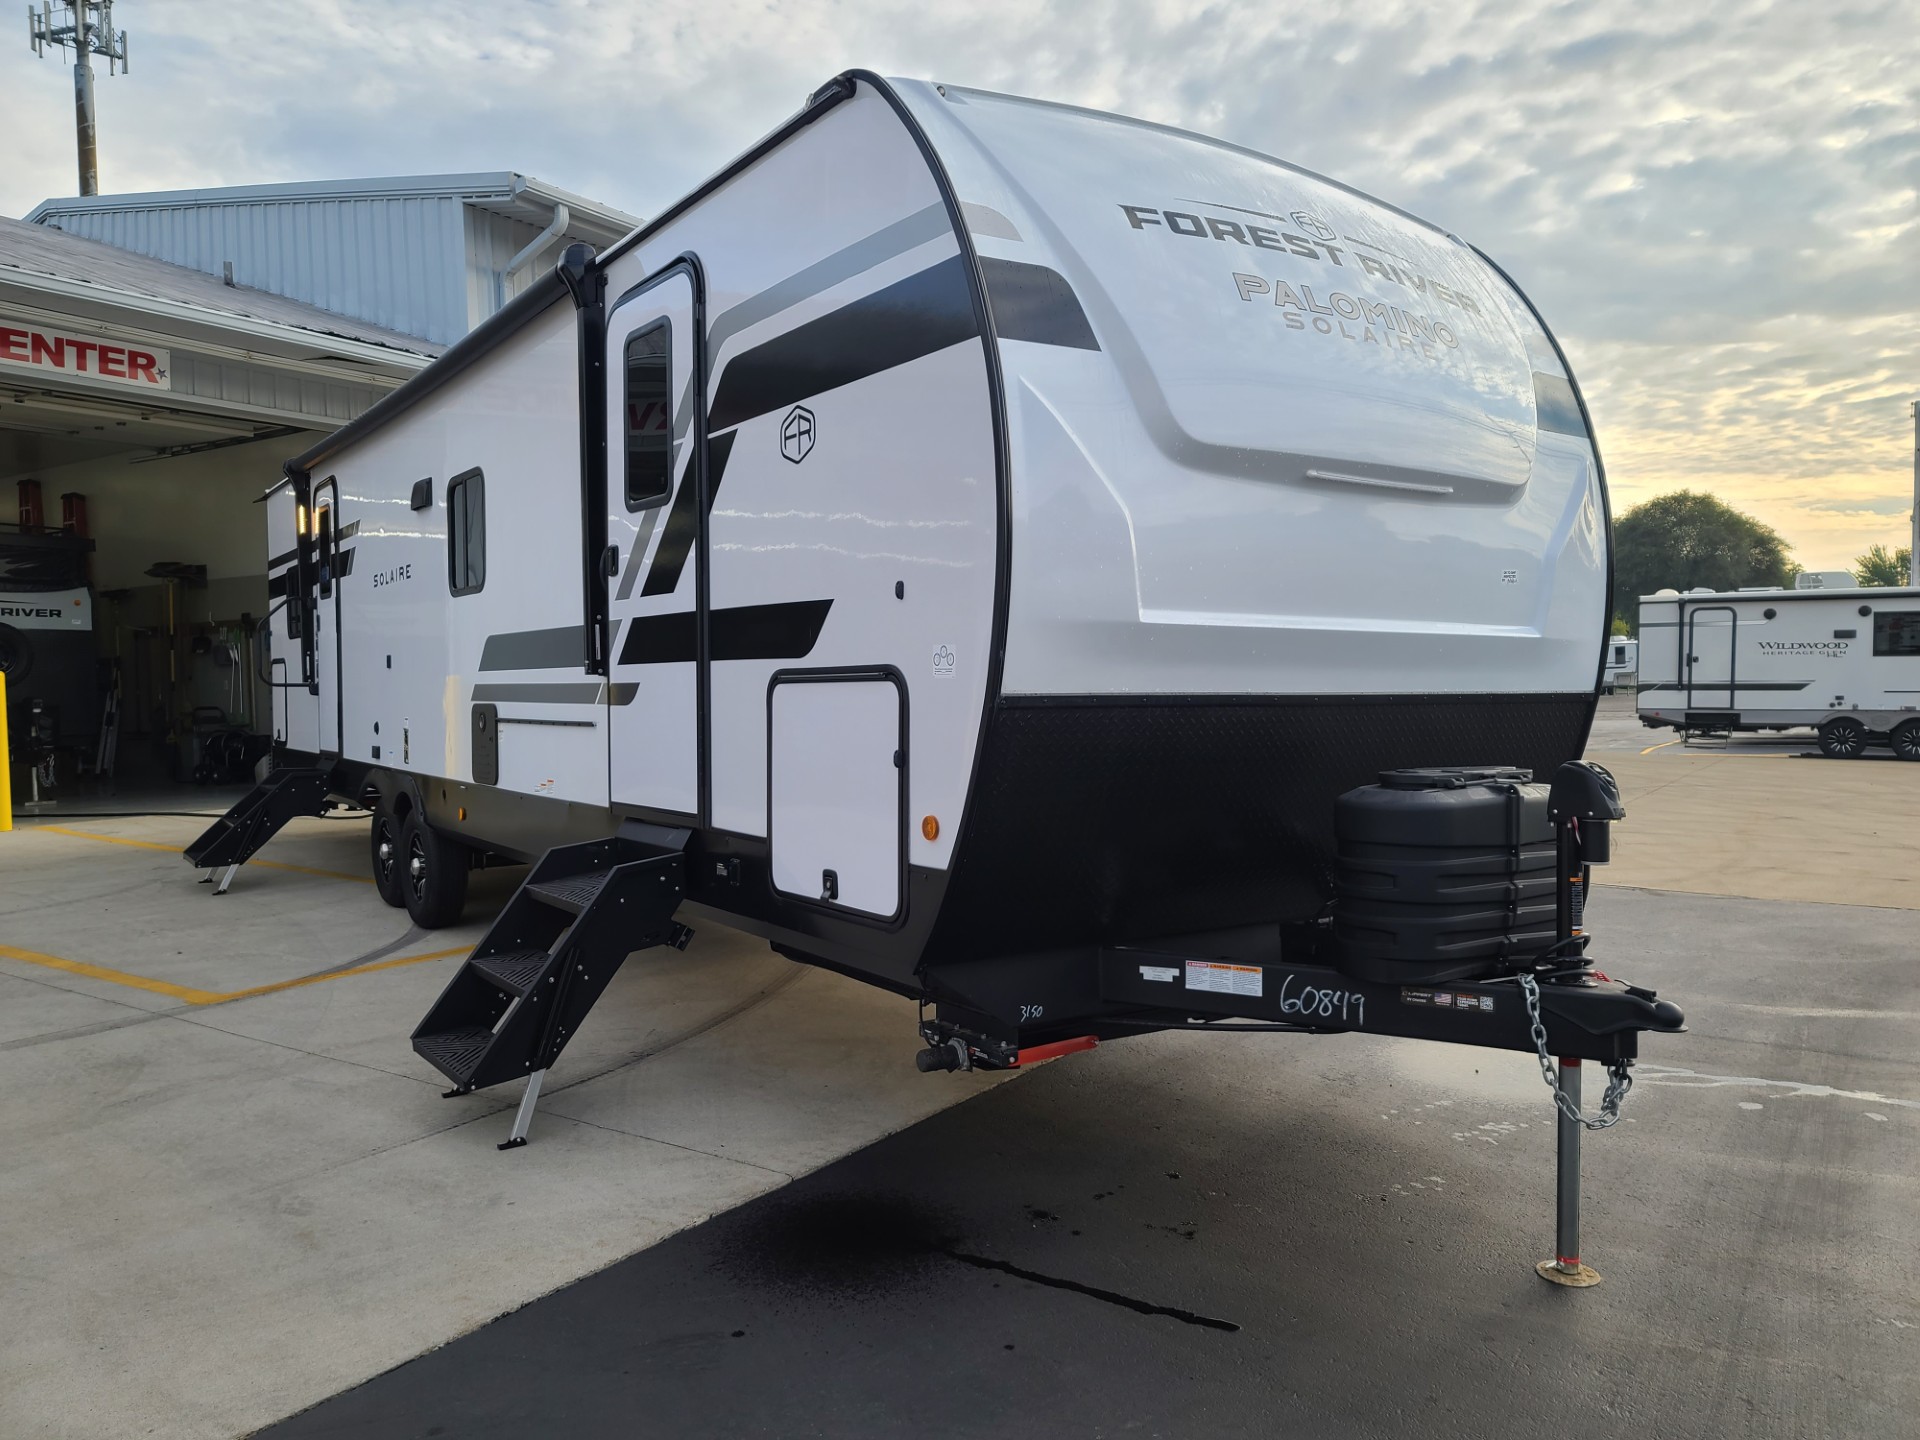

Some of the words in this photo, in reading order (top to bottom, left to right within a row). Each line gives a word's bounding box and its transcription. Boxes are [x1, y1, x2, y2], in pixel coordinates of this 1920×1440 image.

[1116, 204, 1344, 267] FOREST
[1353, 252, 1484, 318] RIVER
[1232, 271, 1460, 349] PALOMINO
[1281, 310, 1440, 362] SOLAIRE
[0, 326, 160, 384] ENTER
[373, 563, 412, 588] SOLAIRE
[0, 607, 63, 618] RIVER
[1020, 1004, 1044, 1023] 3150
[1280, 974, 1366, 1026] 60849
